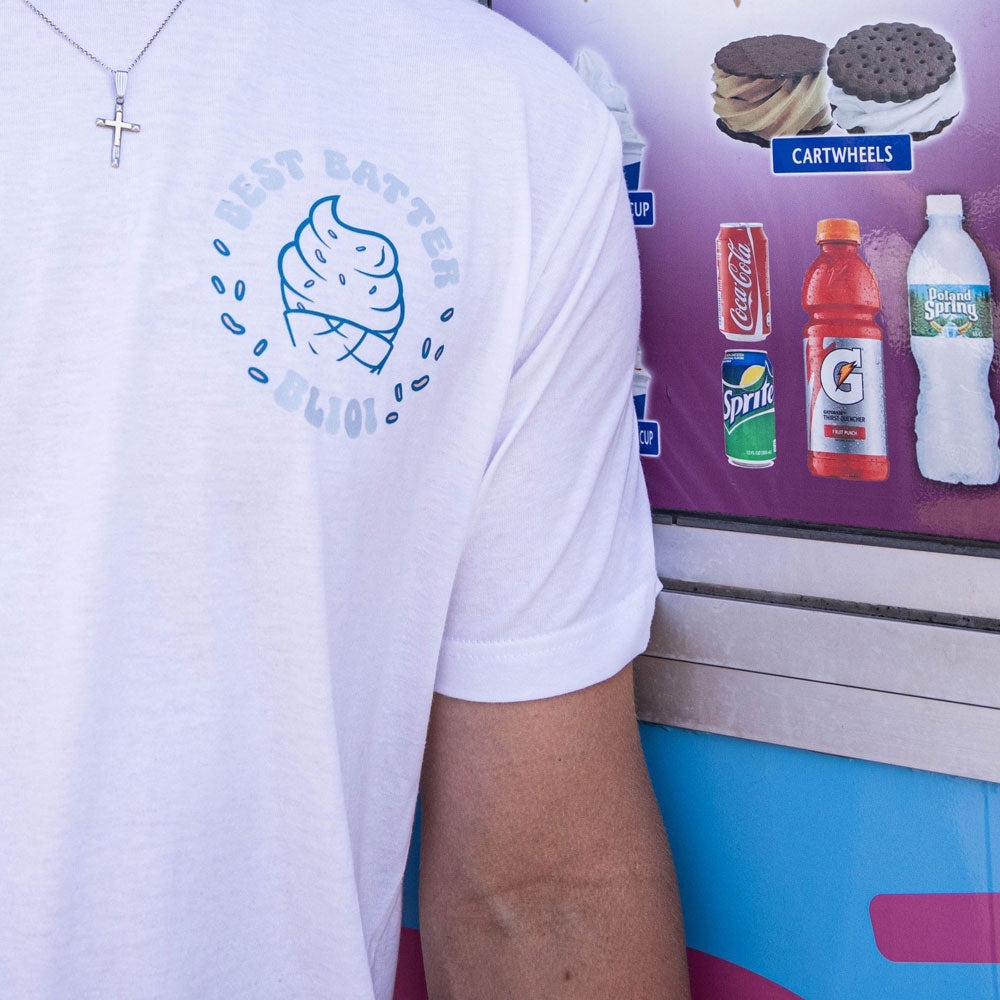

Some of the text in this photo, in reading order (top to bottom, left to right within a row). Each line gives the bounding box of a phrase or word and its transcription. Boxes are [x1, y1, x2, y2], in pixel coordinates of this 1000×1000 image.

[791, 145, 893, 165] CARTWHEELS
[214, 148, 460, 289] BEST BATTER
[928, 287, 972, 303] Poland
[924, 300, 979, 322] Spring
[820, 347, 865, 406] G
[723, 376, 774, 424] Sprite
[639, 430, 654, 445] CUP
